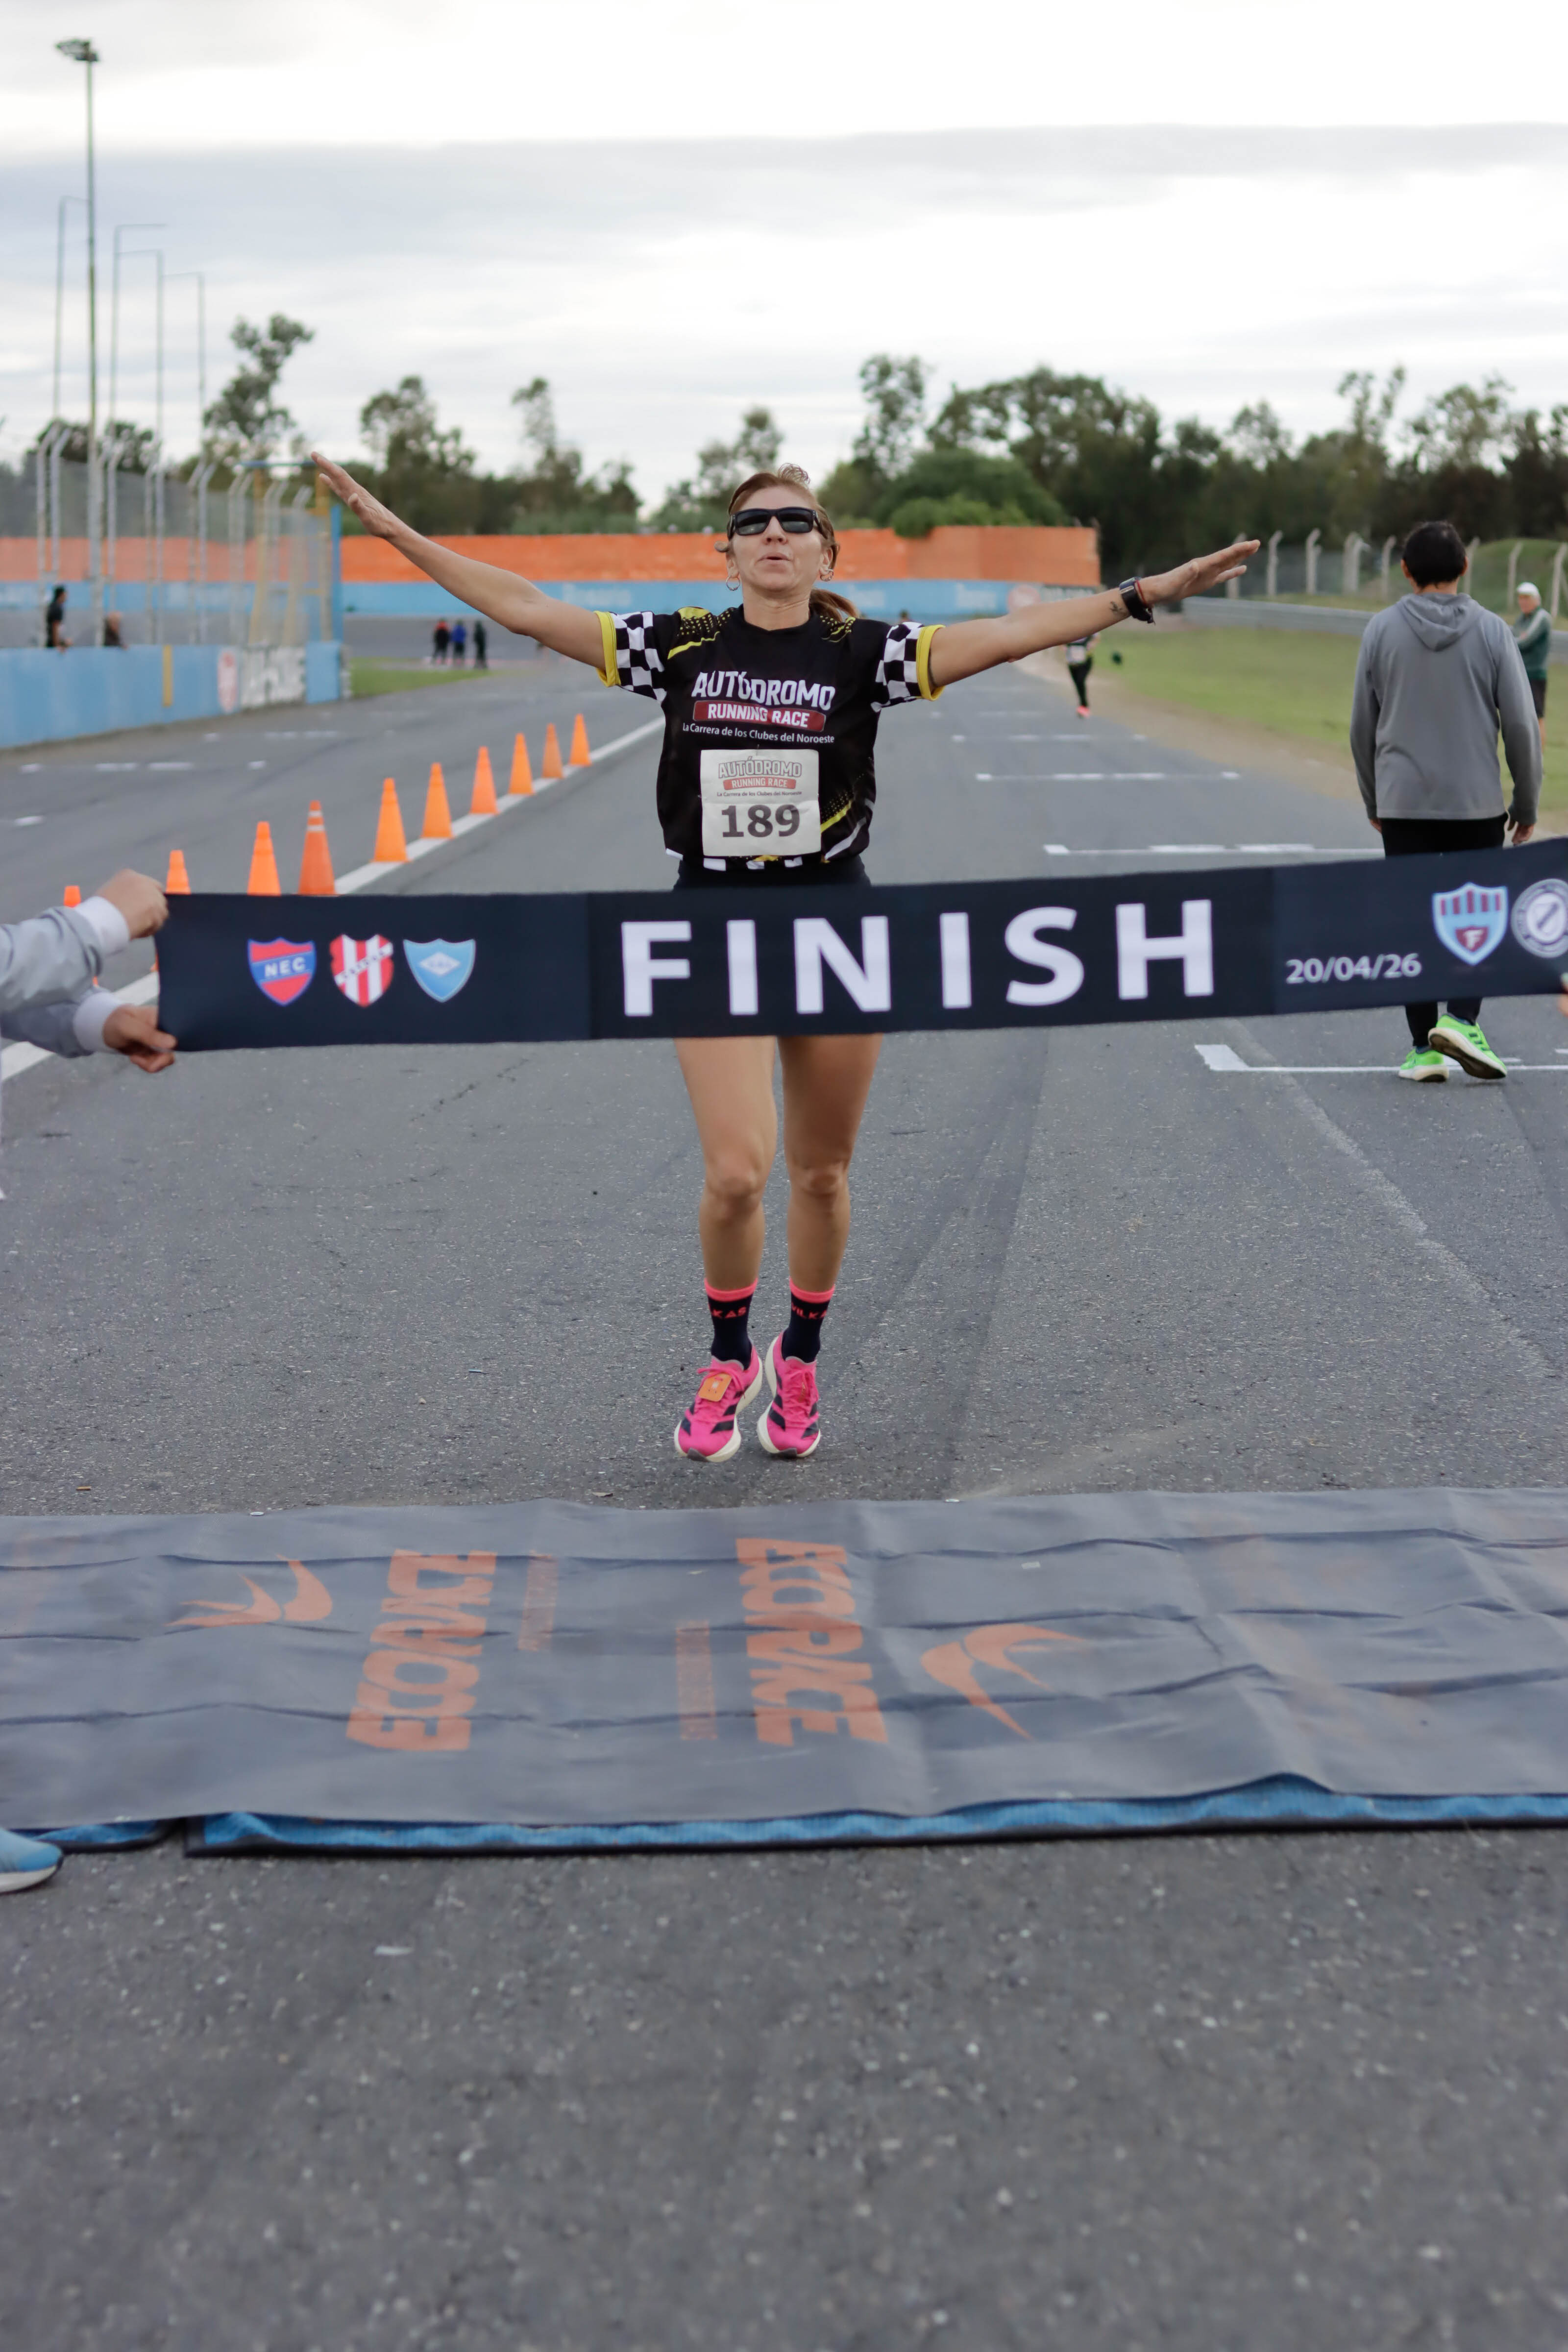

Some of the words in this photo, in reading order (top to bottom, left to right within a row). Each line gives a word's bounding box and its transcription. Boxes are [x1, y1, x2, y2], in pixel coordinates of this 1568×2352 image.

[691, 670, 835, 710] AUTÓDROMO
[708, 704, 768, 721] RUNNING
[772, 710, 810, 727] RACE
[683, 722, 689, 731] La
[690, 723, 719, 735] Carrera
[722, 726, 733, 735] de
[735, 728, 747, 737] los
[749, 730, 778, 741] Clubes
[780, 733, 794, 742] del
[797, 734, 834, 743] Noroeste
[718, 756, 802, 778] AUTÓDROMO
[732, 778, 765, 788] RUNNING
[768, 779, 787, 788] RACE
[721, 804, 800, 837] 189
[621, 900, 1214, 1017] FINISH
[1286, 953, 1422, 984] 20/04/26
